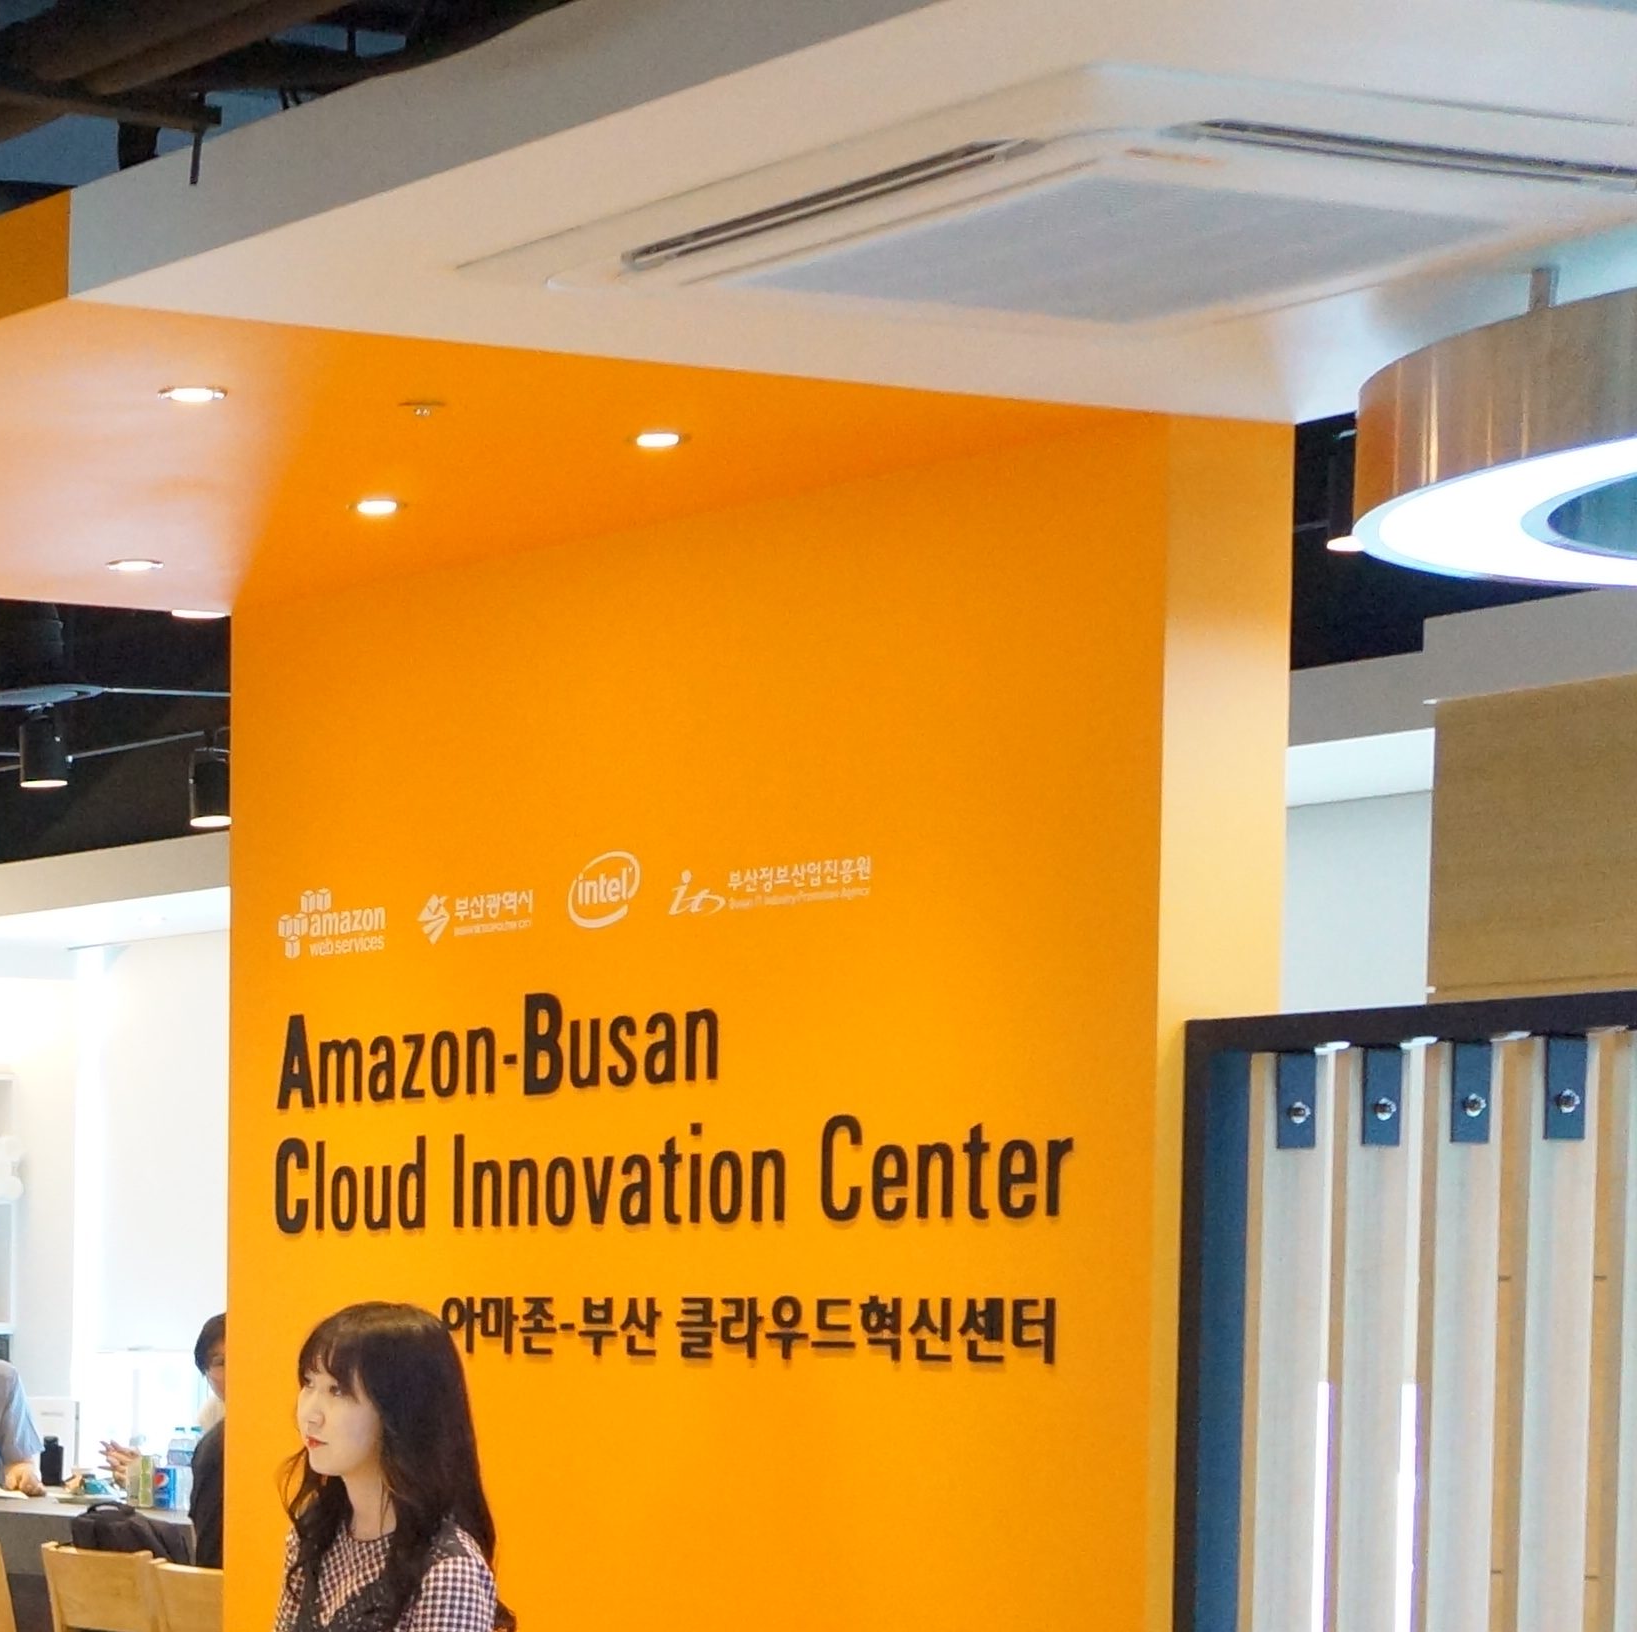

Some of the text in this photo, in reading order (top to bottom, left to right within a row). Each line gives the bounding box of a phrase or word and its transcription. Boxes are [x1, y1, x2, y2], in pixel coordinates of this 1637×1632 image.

[578, 866, 629, 906] intel
[728, 855, 872, 893] 부산정보산업진흥원
[309, 906, 387, 938] amazon
[454, 889, 534, 921] 부산광역시
[276, 991, 720, 1110] Amazon-Busan
[275, 1113, 1075, 1235] Cloud Innovation Center
[440, 1295, 1058, 1365] 아마존-부산 클라우드혁신센터
